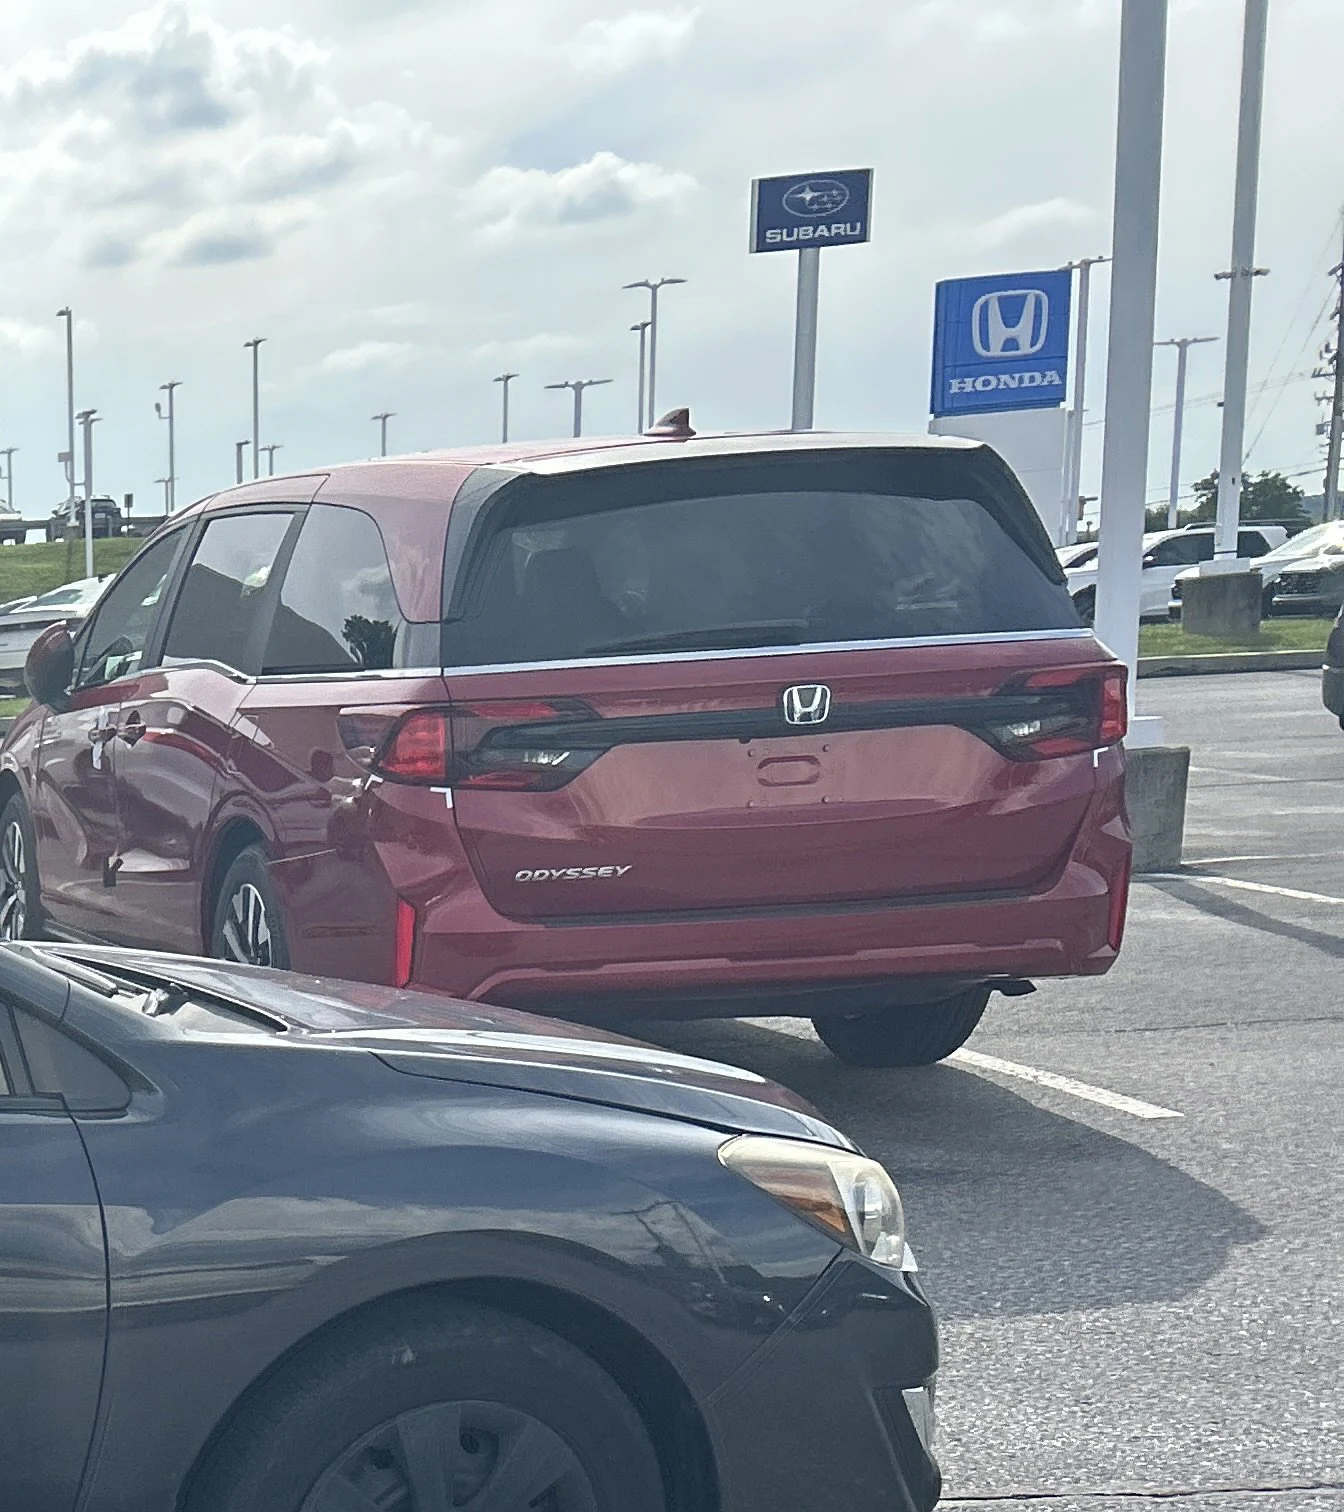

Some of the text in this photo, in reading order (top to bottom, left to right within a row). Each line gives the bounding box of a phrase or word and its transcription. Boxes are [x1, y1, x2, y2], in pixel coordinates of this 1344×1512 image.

[765, 222, 861, 243] SUBARU
[949, 370, 1063, 394] HONDA
[515, 865, 632, 881] ODYSSEY
